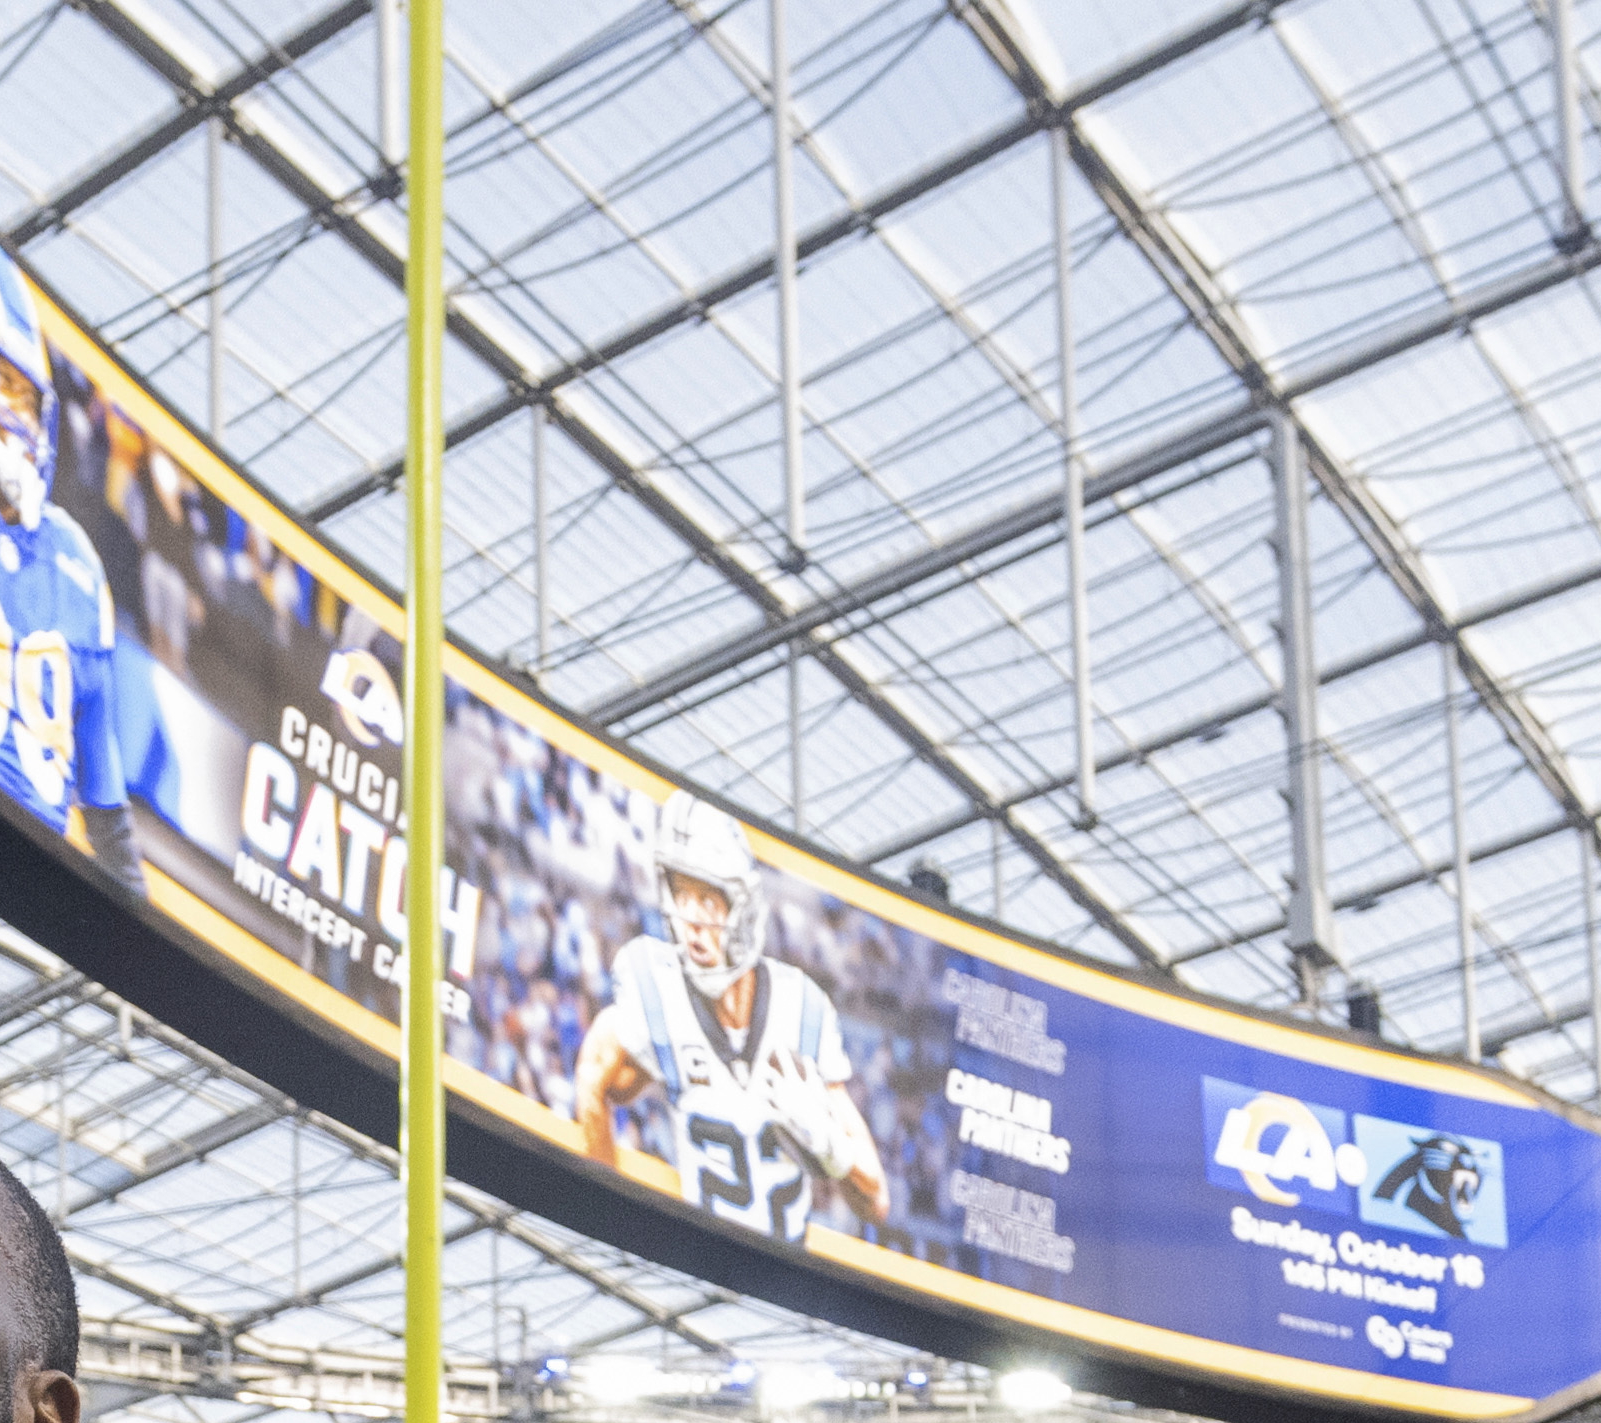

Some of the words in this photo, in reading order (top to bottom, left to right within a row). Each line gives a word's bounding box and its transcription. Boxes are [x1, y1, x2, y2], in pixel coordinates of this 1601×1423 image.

[279, 706, 409, 830] CRUCI
[233, 852, 367, 962] INTERCEPT
[373, 942, 472, 1026] CAER
[1231, 1207, 1337, 1265] Sunday,
[1337, 1231, 1448, 1283] October
